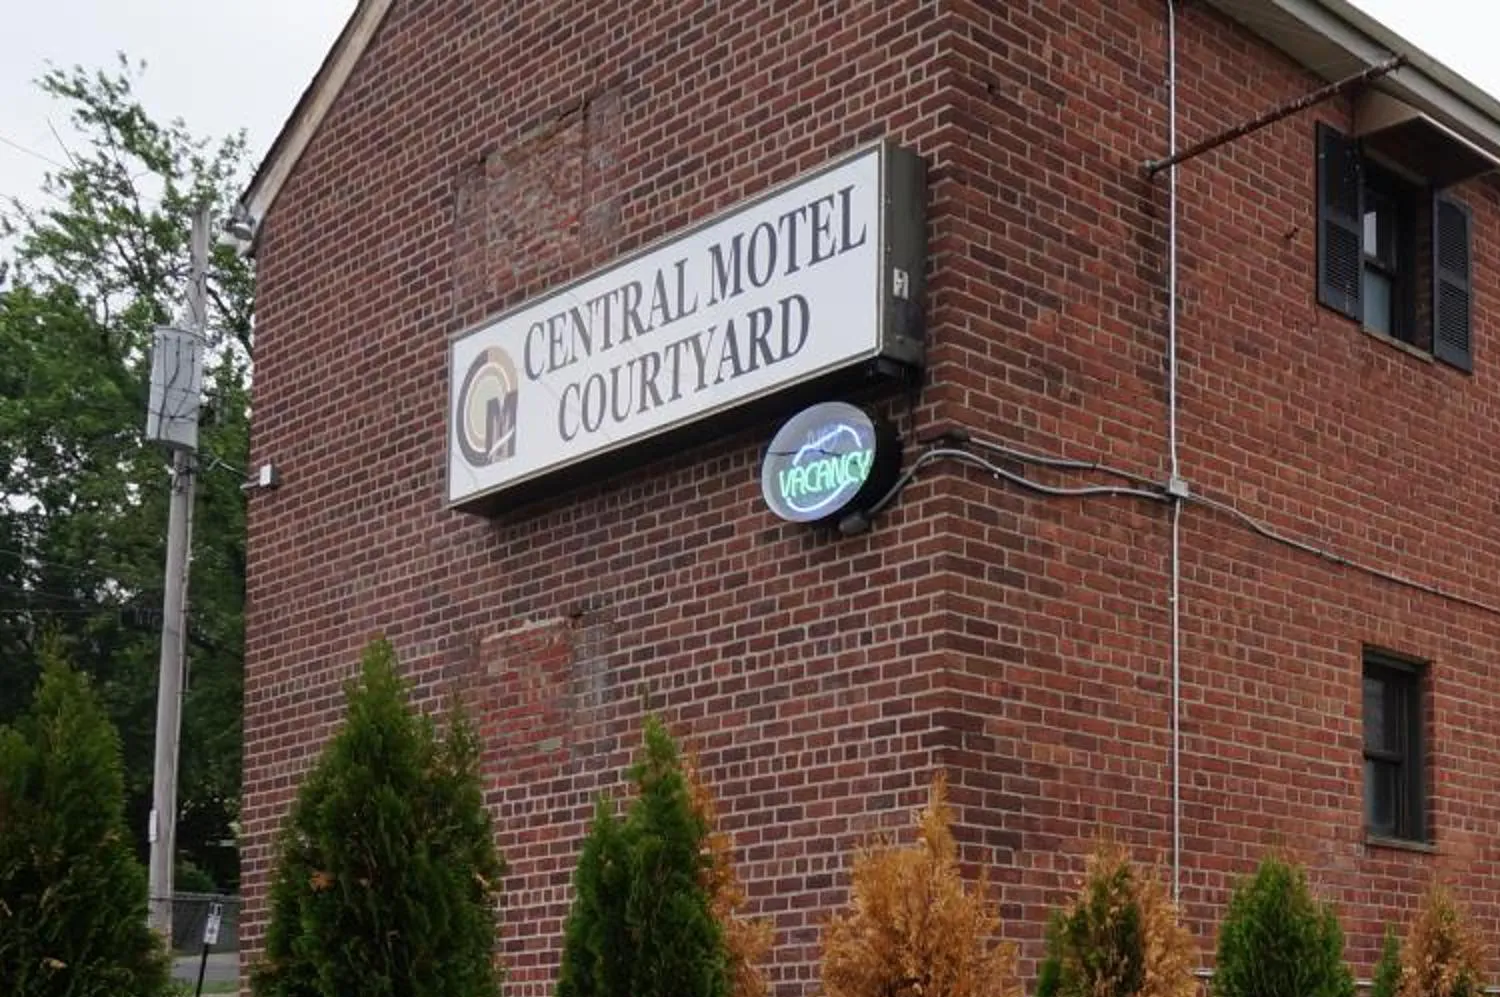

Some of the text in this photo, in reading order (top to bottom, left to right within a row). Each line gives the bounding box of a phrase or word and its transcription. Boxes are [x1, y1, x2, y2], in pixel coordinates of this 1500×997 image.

[523, 184, 867, 381] CENTRAL MOTEL
[558, 293, 811, 442] COURTYARD
[778, 448, 873, 498] VACANCY
